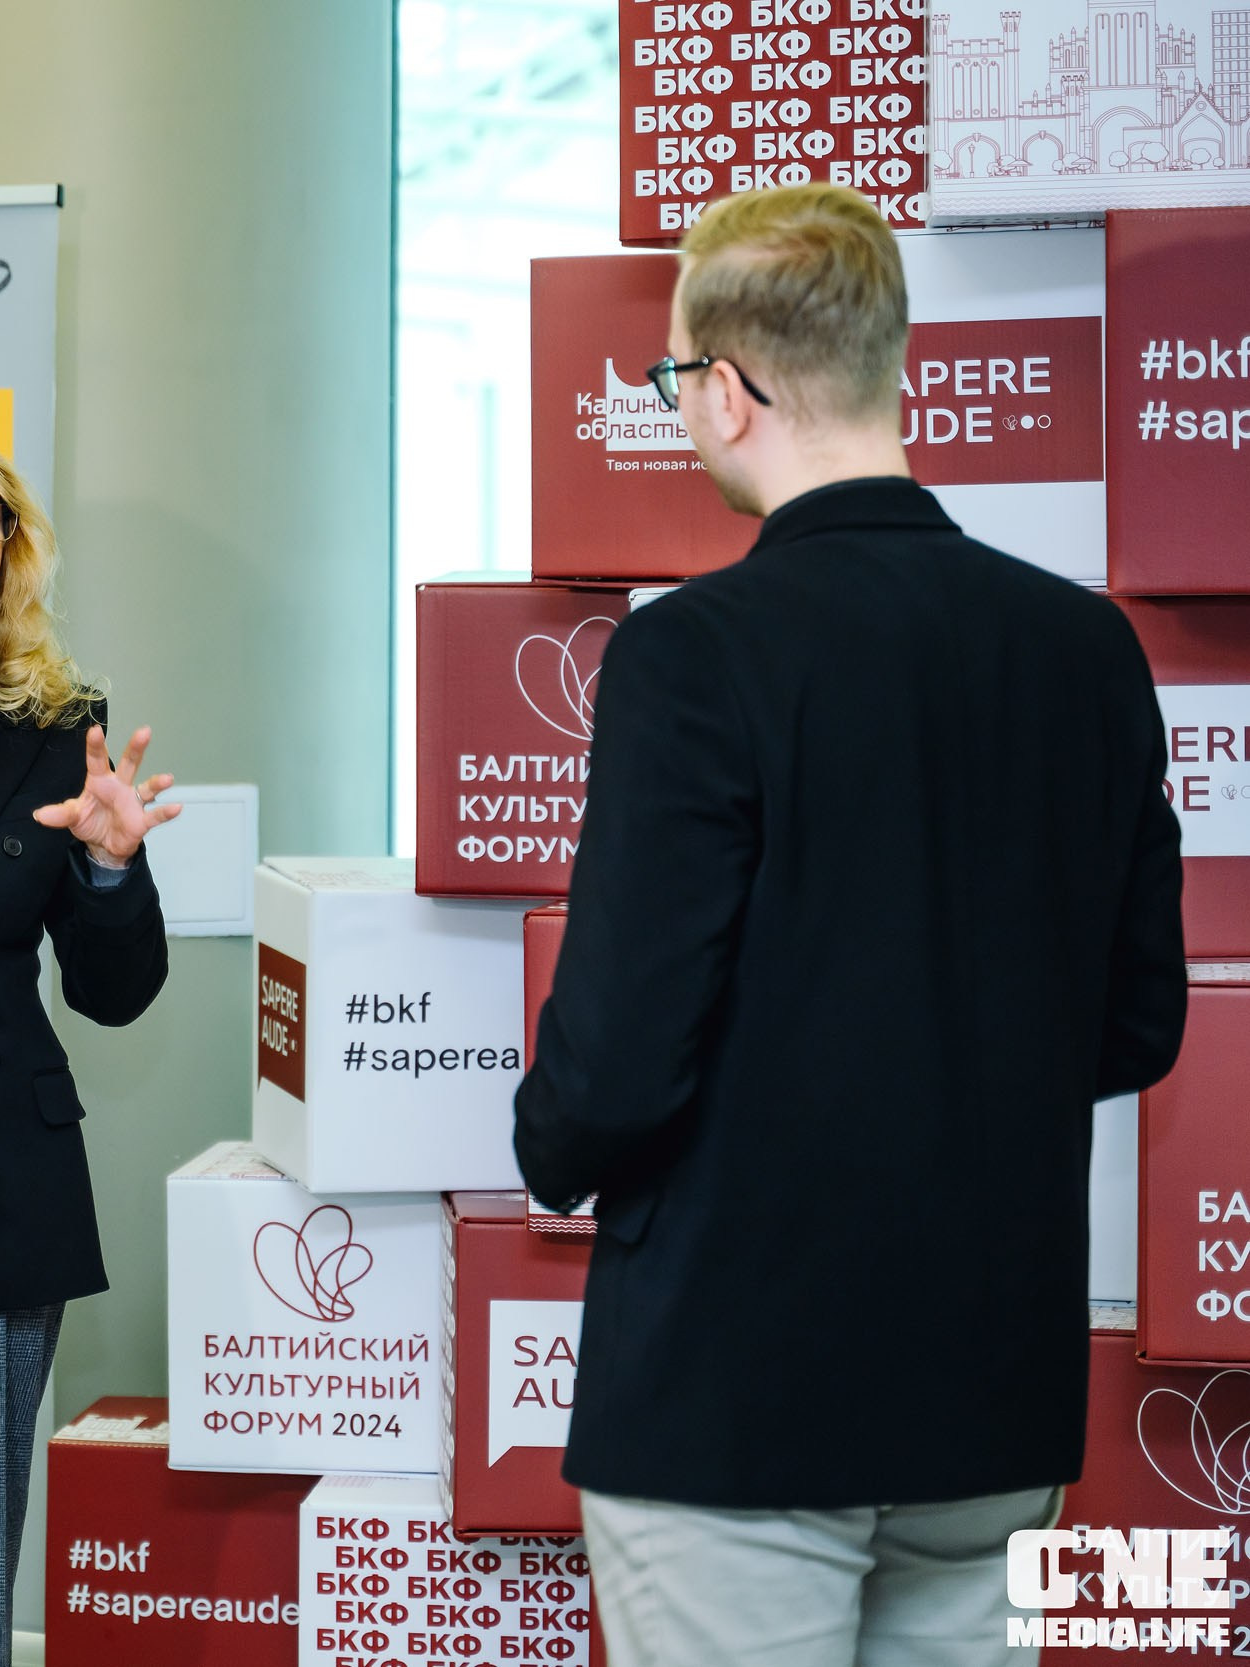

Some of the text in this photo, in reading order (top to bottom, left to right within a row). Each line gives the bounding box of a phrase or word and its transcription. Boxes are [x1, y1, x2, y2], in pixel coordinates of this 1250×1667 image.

[655, 2, 733, 32] БКФ
[750, 0, 831, 27] БКФ
[634, 24, 912, 66] БКФ БКФ БКФ
[654, 55, 926, 96] БКФ БКФ БКФ
[634, 93, 912, 133] БКФ БКФ БКФ
[658, 125, 926, 164] БКФ БКФ БКФ
[635, 158, 912, 196] БКФ БКФ БКФ
[660, 192, 926, 230] БК КФ
[1140, 336, 1250, 380] #bkf
[577, 392, 678, 415] Калини
[576, 418, 688, 440] область
[606, 459, 639, 471] Твоя
[644, 461, 687, 471] новая
[1172, 726, 1250, 762] ER
[459, 795, 588, 823] КУЛЬТУ
[261, 975, 298, 1022] SAPERE
[345, 991, 432, 1024] #bkf
[261, 1015, 288, 1057] AUDE
[343, 1042, 521, 1079] #saperea
[1199, 1191, 1250, 1223] БА
[1199, 1241, 1250, 1272] КУ
[204, 1331, 430, 1363] БАЛТИЙСКИЙ
[514, 1335, 578, 1367] SA
[205, 1371, 421, 1401] КУЛЬТУРНЫЙ
[203, 1409, 402, 1438] ФОРУМ 2024
[316, 1516, 390, 1541] БКФ
[1071, 1524, 1250, 1563] БАЛТИЙ
[69, 1540, 150, 1573] #bkf
[336, 1546, 590, 1578] БКФ БКФ БКФ
[316, 1572, 575, 1604] БКФ БКФ БКФ
[67, 1584, 300, 1625] #sapereaude
[336, 1601, 590, 1632] БКФ БКФ БКФ
[316, 1629, 575, 1661] БКФ БКФ БКФ
